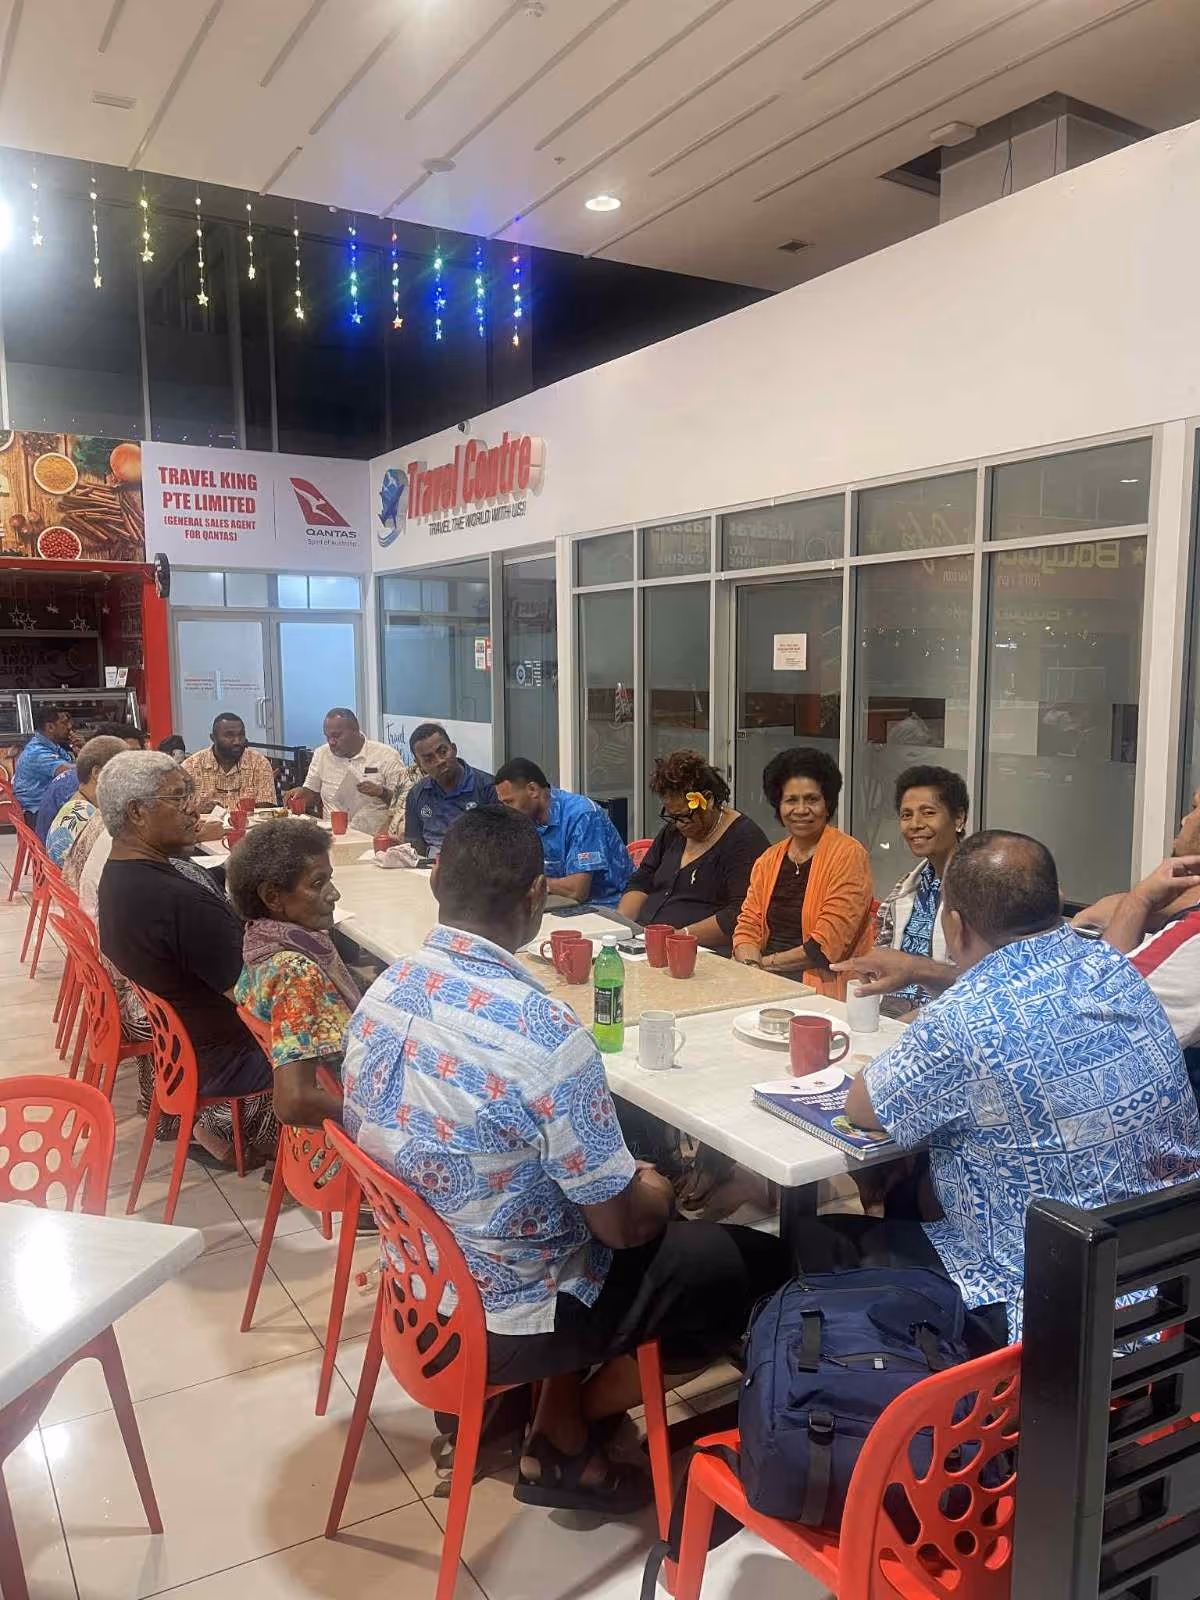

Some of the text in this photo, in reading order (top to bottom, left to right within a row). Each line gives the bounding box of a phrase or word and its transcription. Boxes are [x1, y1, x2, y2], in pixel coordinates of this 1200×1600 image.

[158, 466, 257, 491] TRAVEL KING
[162, 491, 256, 514] PTE LIMITED
[164, 515, 256, 530] (GENERAL SALES AGENT
[428, 520, 451, 536] TRAVEL
[452, 516, 465, 531] THE
[465, 510, 490, 527] WORLD
[491, 507, 511, 523] WITH
[184, 529, 238, 541] FOR QANTAS)
[305, 528, 357, 539] QANTAS
